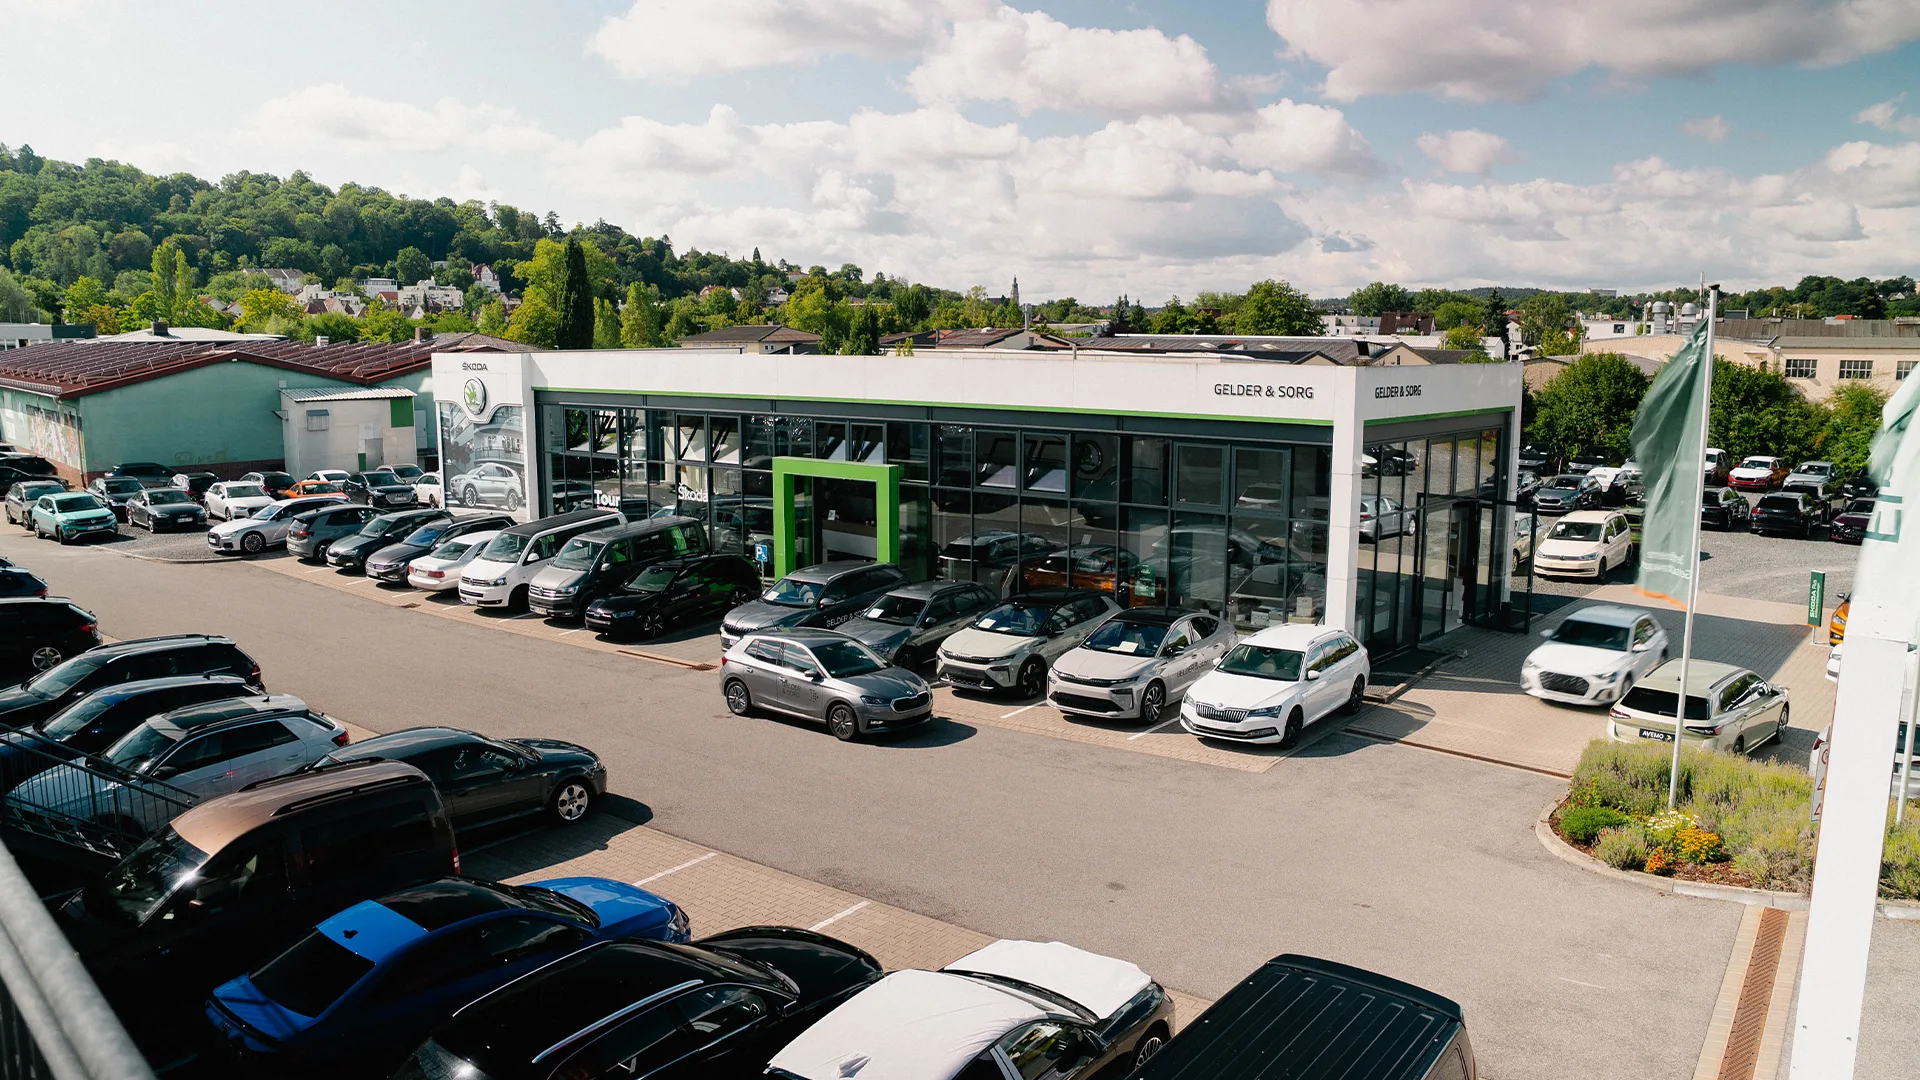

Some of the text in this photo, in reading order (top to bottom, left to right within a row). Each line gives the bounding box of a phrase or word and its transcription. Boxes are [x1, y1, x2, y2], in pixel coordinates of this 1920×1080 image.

[1214, 383, 1313, 399] GELDER & SORG
[1375, 385, 1421, 399] GELDER & SORG
[594, 489, 620, 507] Tour
[678, 482, 708, 502] Škoda
[757, 546, 763, 559] P
[826, 614, 848, 627] GELDER
